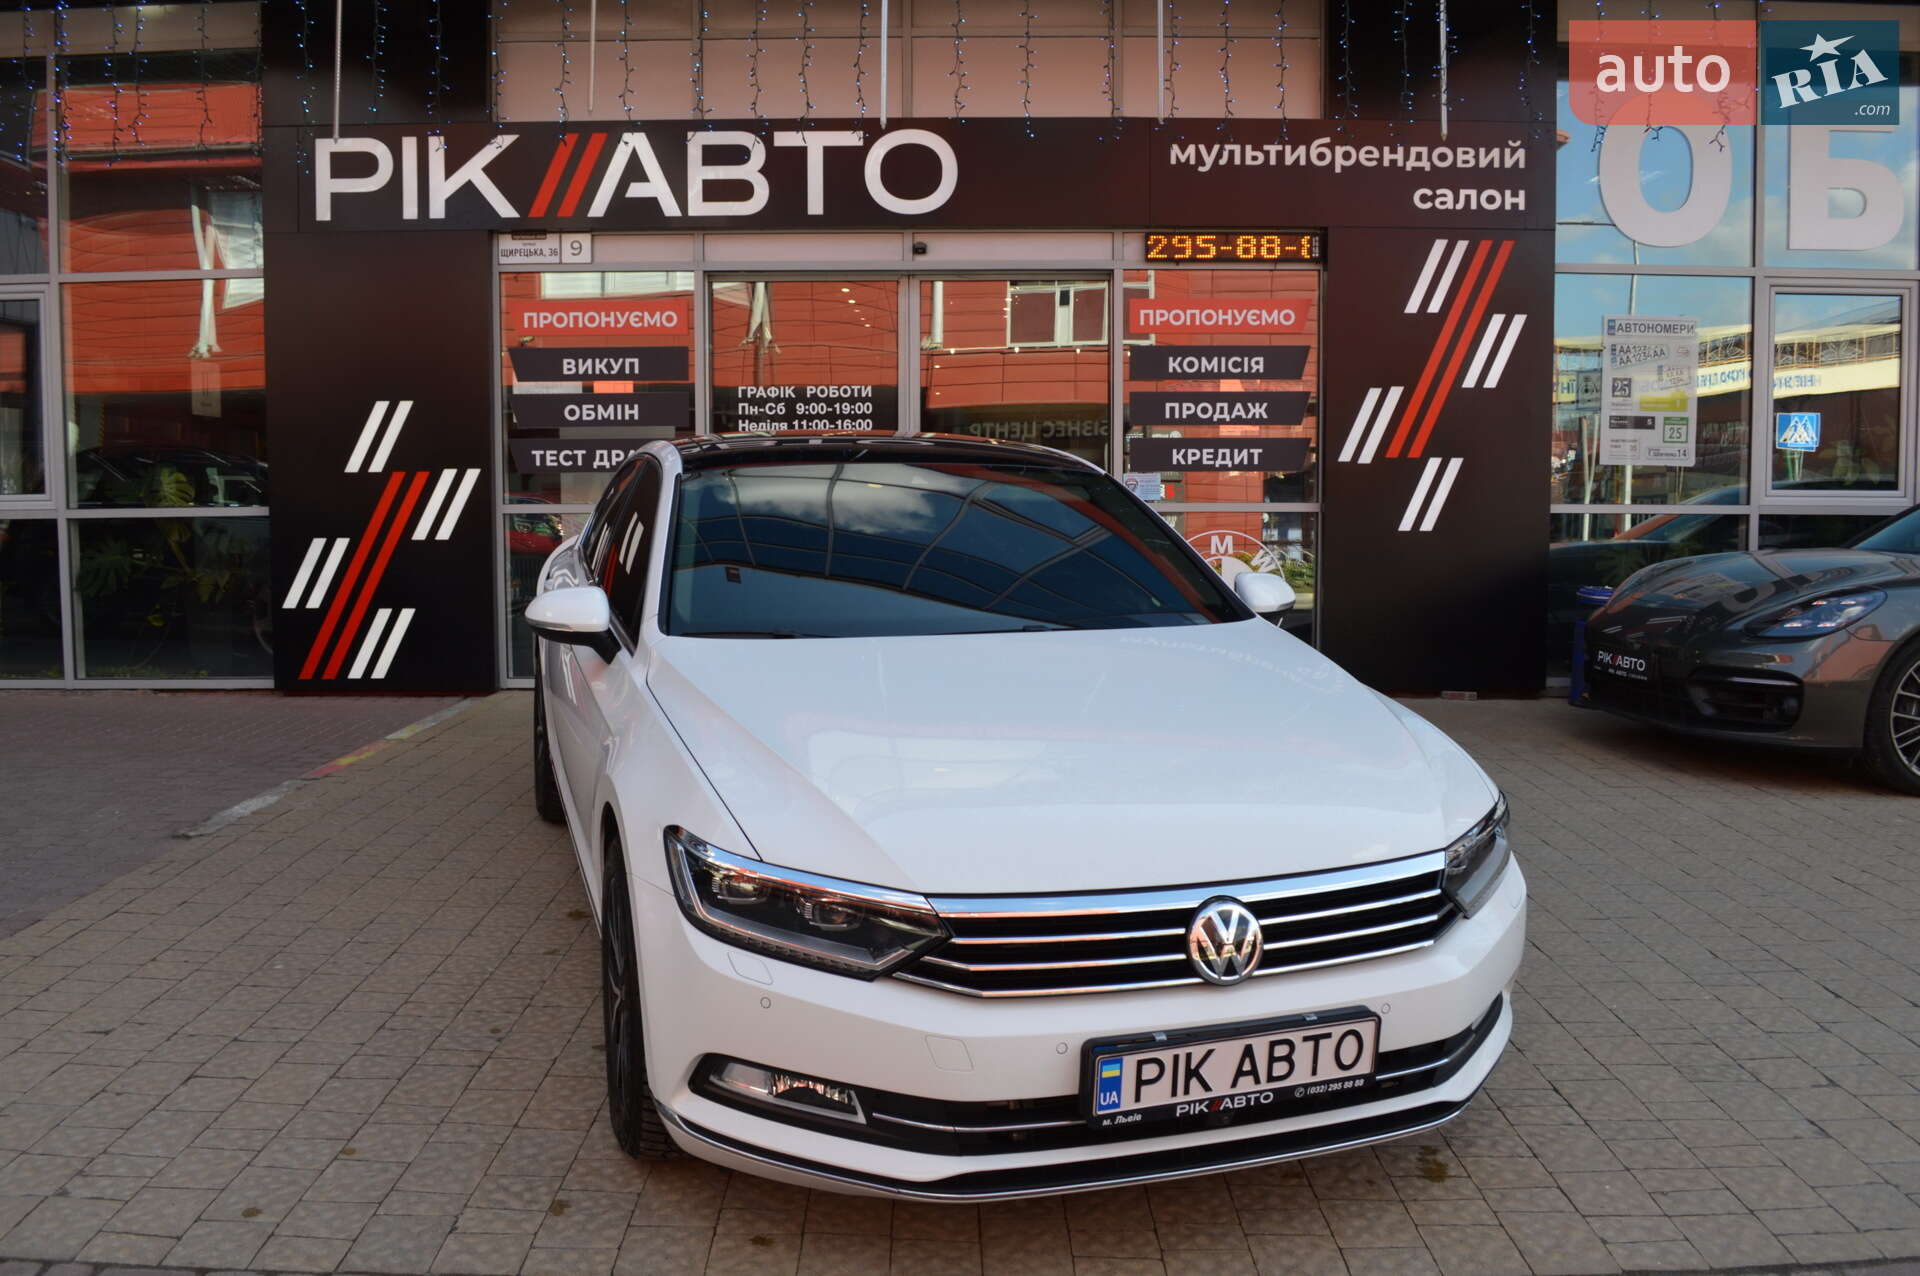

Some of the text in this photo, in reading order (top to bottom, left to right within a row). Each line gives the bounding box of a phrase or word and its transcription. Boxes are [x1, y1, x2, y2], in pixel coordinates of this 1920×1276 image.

[1169, 136, 1526, 173] мультибрендовий
[315, 128, 959, 221] РІК АВТО
[1413, 187, 1526, 211] салон
[570, 240, 583, 257] 9
[523, 311, 678, 328] ПРОПОНУЄМО
[1139, 309, 1296, 325] ПРОПОНУЄМО
[1616, 322, 1695, 334] АВТОНОМЕРИ
[562, 358, 639, 375] ВИКУП
[1168, 356, 1264, 373] КОМІСІЯ
[737, 385, 872, 398] ГРАФІК РОБОТИ
[1614, 380, 1630, 396] 25
[564, 404, 639, 421] ОБМІН
[737, 402, 873, 415] Пн-Сб 9:00-19:00
[1165, 402, 1268, 422] ПРОДАЖ
[737, 419, 873, 432] Неділя 11:00-16:00
[1668, 427, 1682, 440] 25
[531, 450, 586, 467] ТЕСТ
[1171, 448, 1263, 468] КРЕДИТ
[1133, 1028, 1364, 1103] РІК АВТО
[1099, 1091, 1118, 1106] UA
[1176, 1091, 1274, 1118] РІК АВТО
